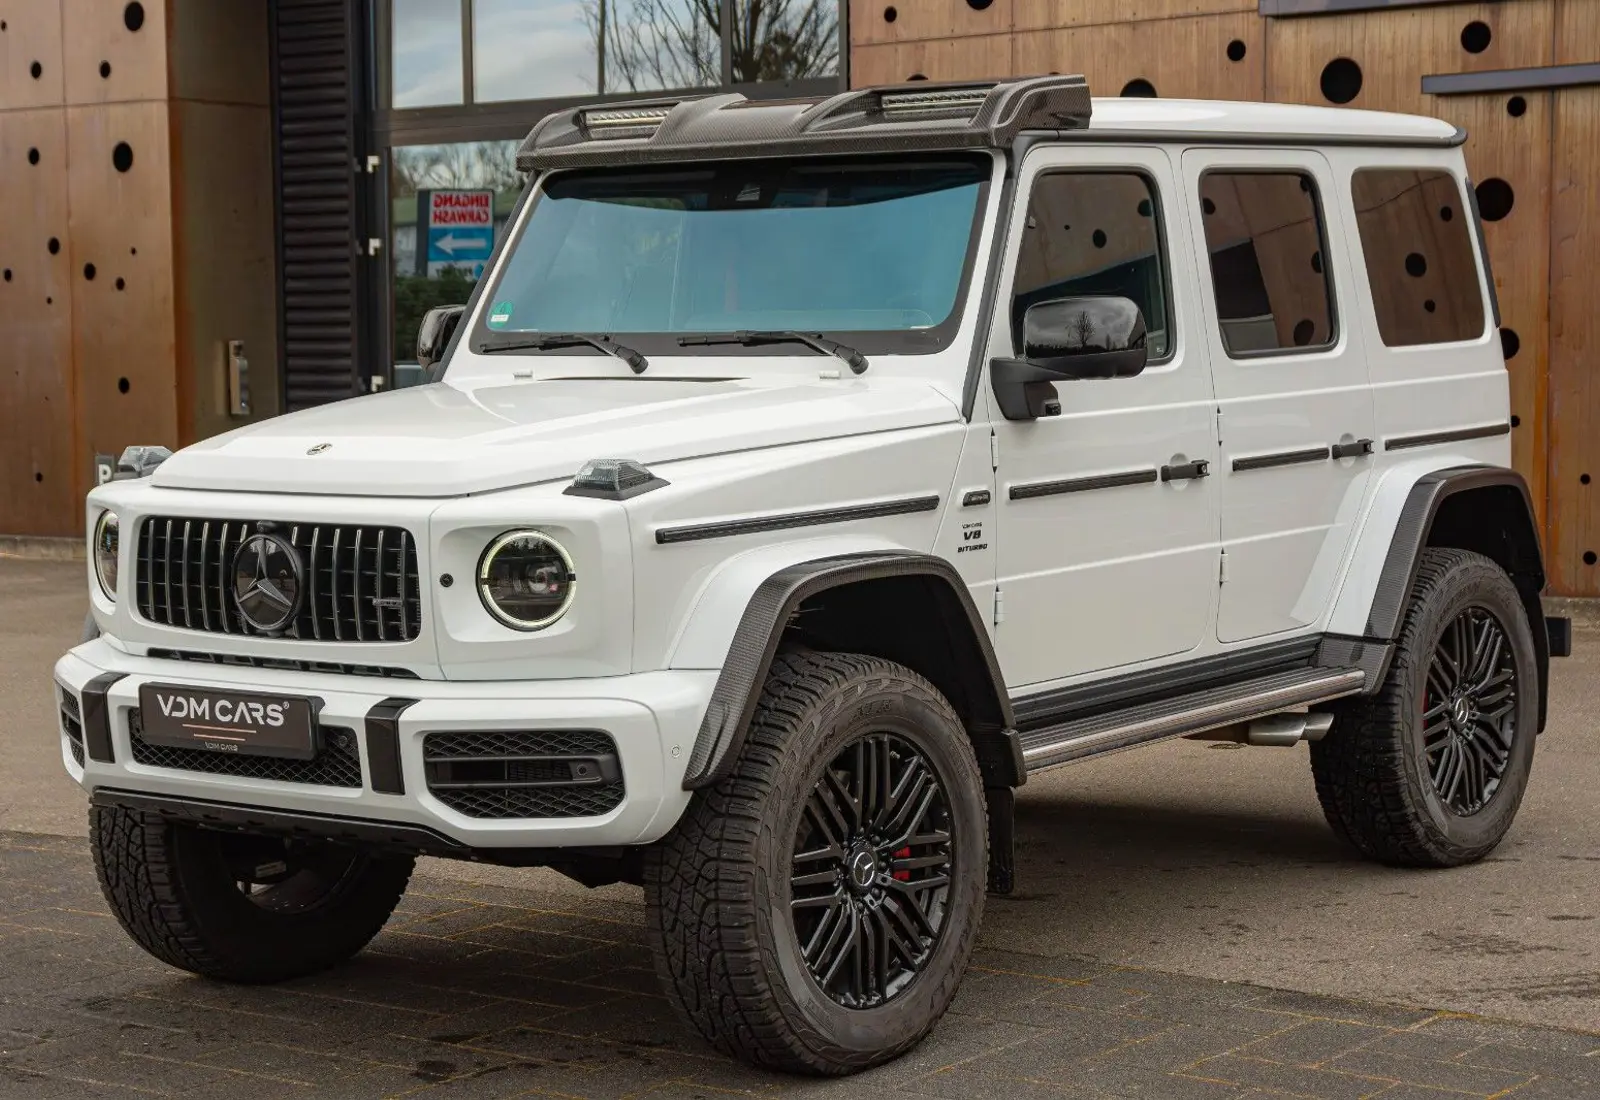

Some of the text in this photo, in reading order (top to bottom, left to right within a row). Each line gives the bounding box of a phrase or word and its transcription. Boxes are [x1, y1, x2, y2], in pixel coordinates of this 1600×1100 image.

[98, 464, 112, 486] P
[963, 530, 982, 540] V8
[957, 544, 987, 553] BITURBO
[156, 694, 210, 720] VDM
[220, 743, 238, 752] CARS
